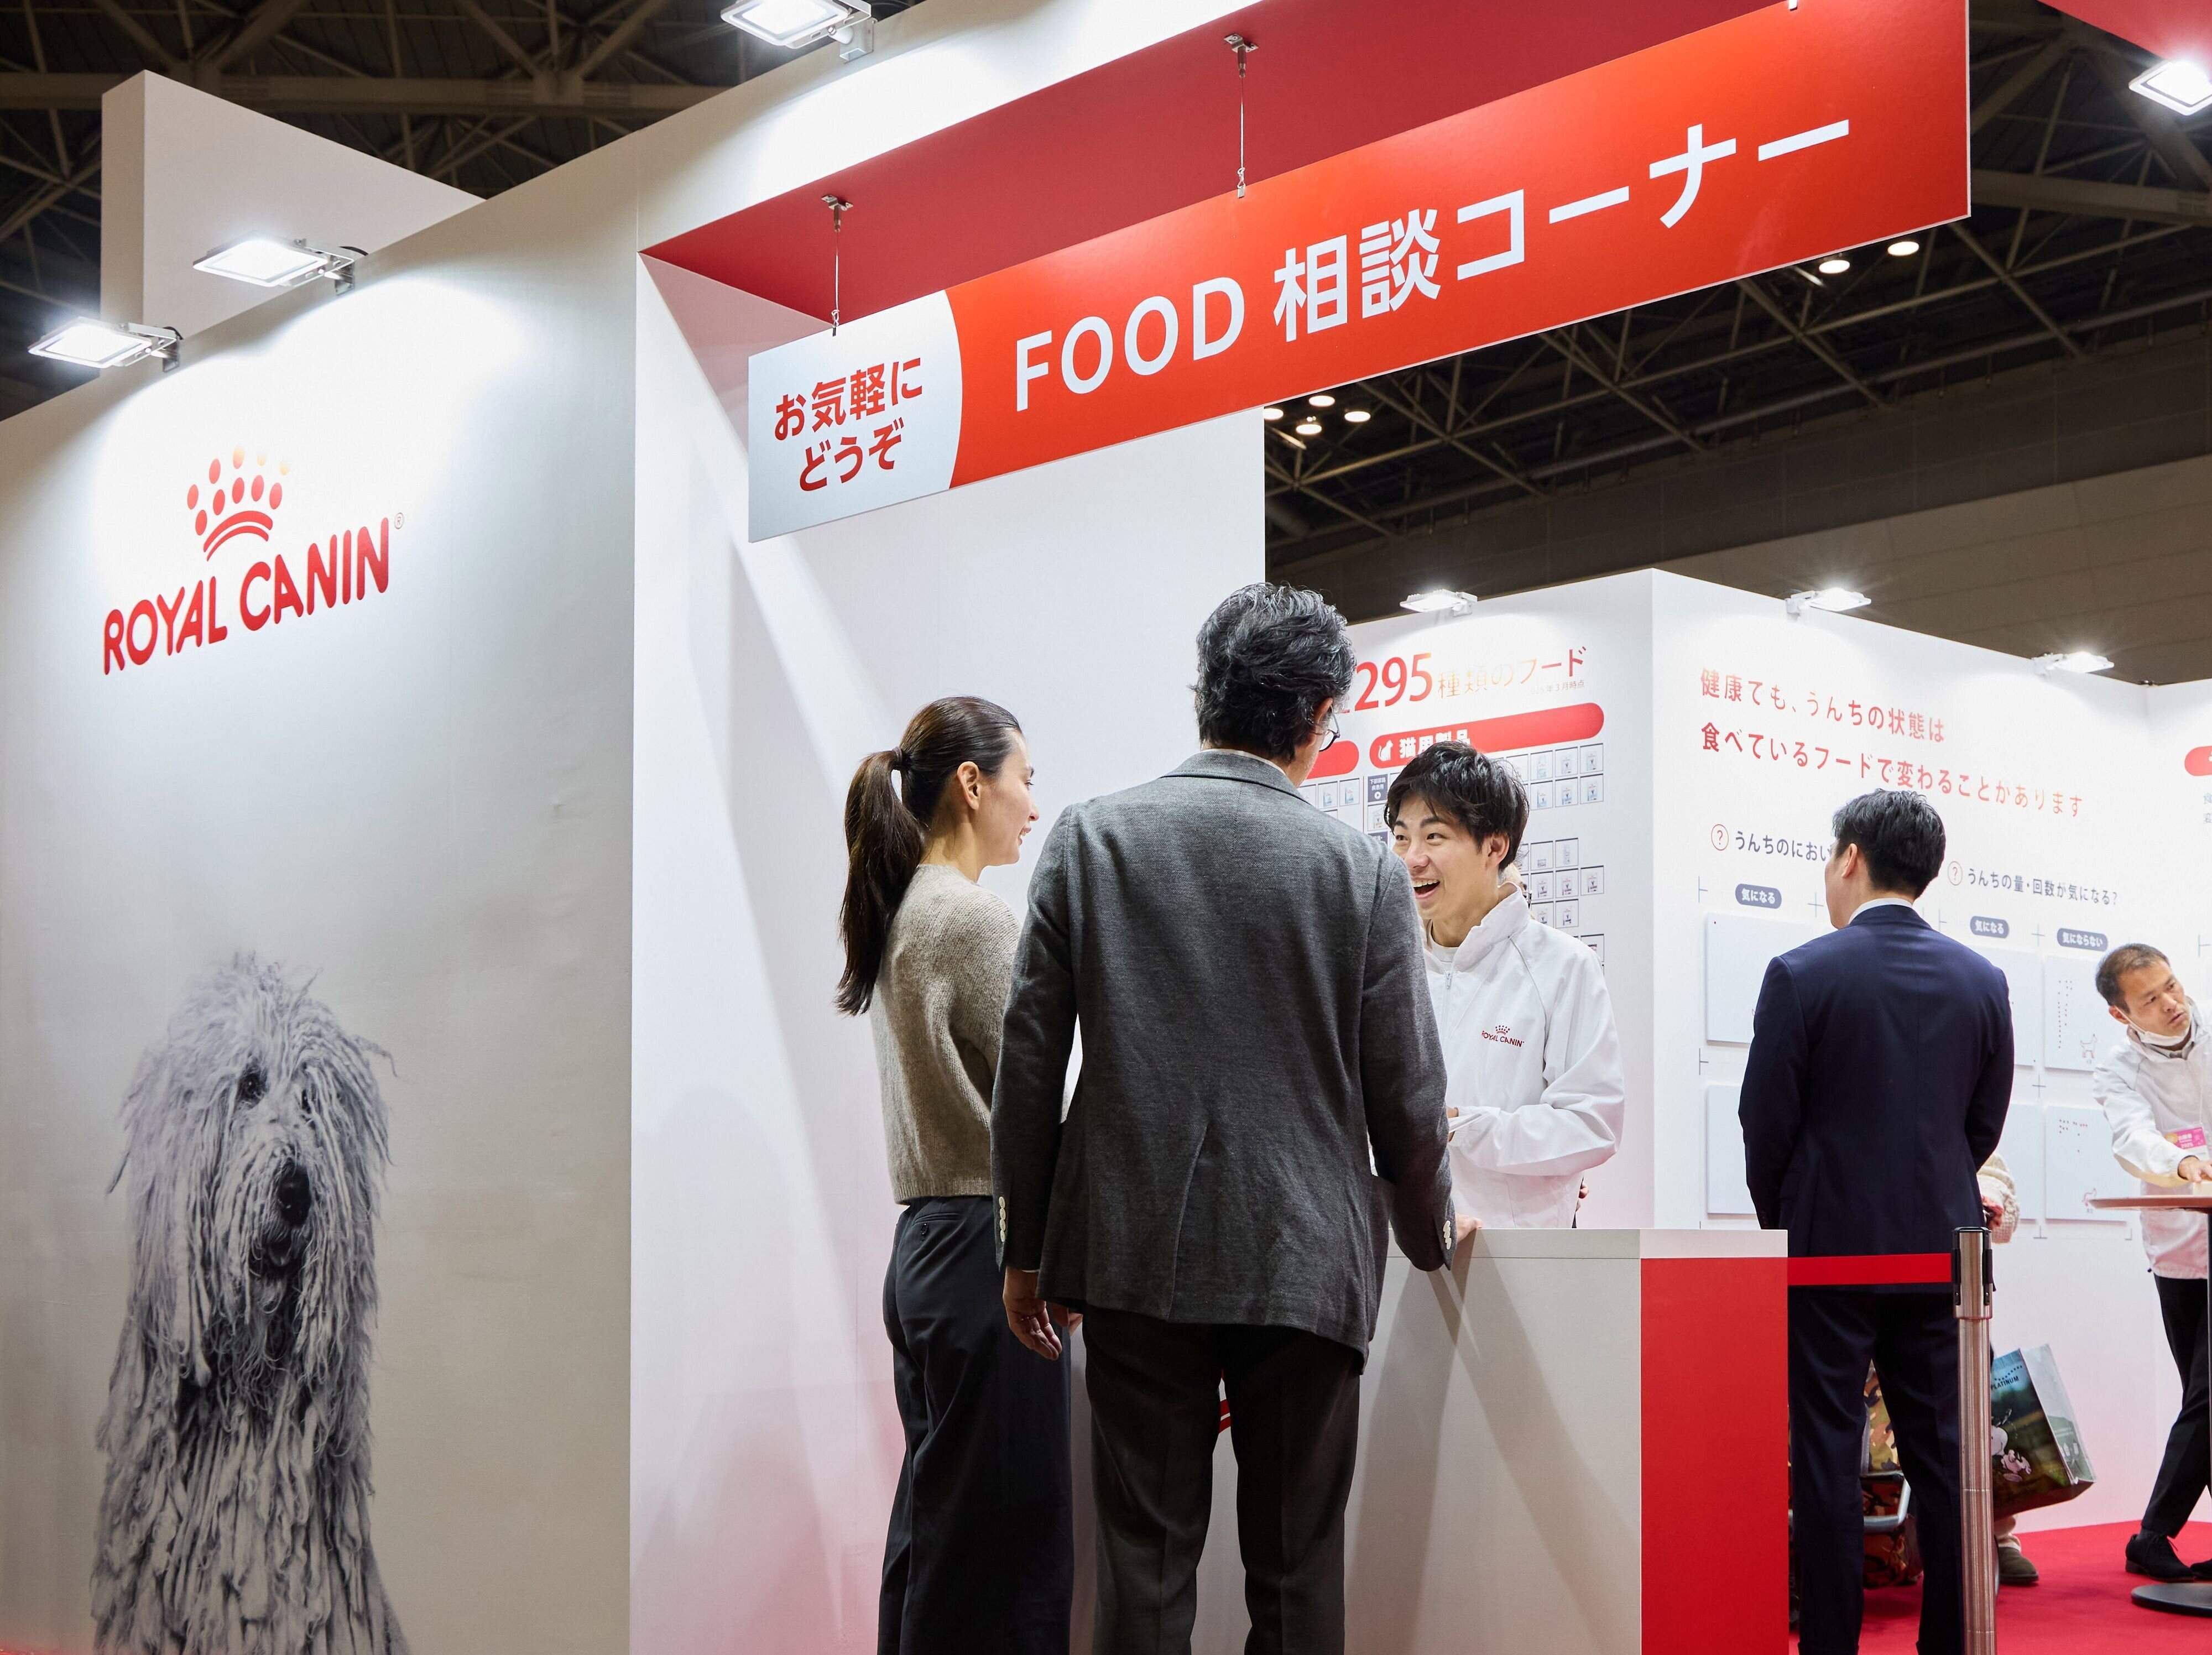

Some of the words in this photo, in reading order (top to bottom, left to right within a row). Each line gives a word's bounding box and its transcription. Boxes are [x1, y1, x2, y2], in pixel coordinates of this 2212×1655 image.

[1016, 276, 1245, 412] FOOD
[1273, 118, 1850, 343] 相談コーナー
[774, 357, 923, 441] お気軽に
[799, 416, 905, 492] どうぞ
[104, 575, 228, 676] ROYAL
[239, 516, 389, 632] CANIN
[1344, 645, 1587, 714] 295種類のフード
[1741, 887, 1776, 905] 気になる
[1974, 919, 2005, 934] 気になる
[2061, 931, 2104, 948] 気にならない
